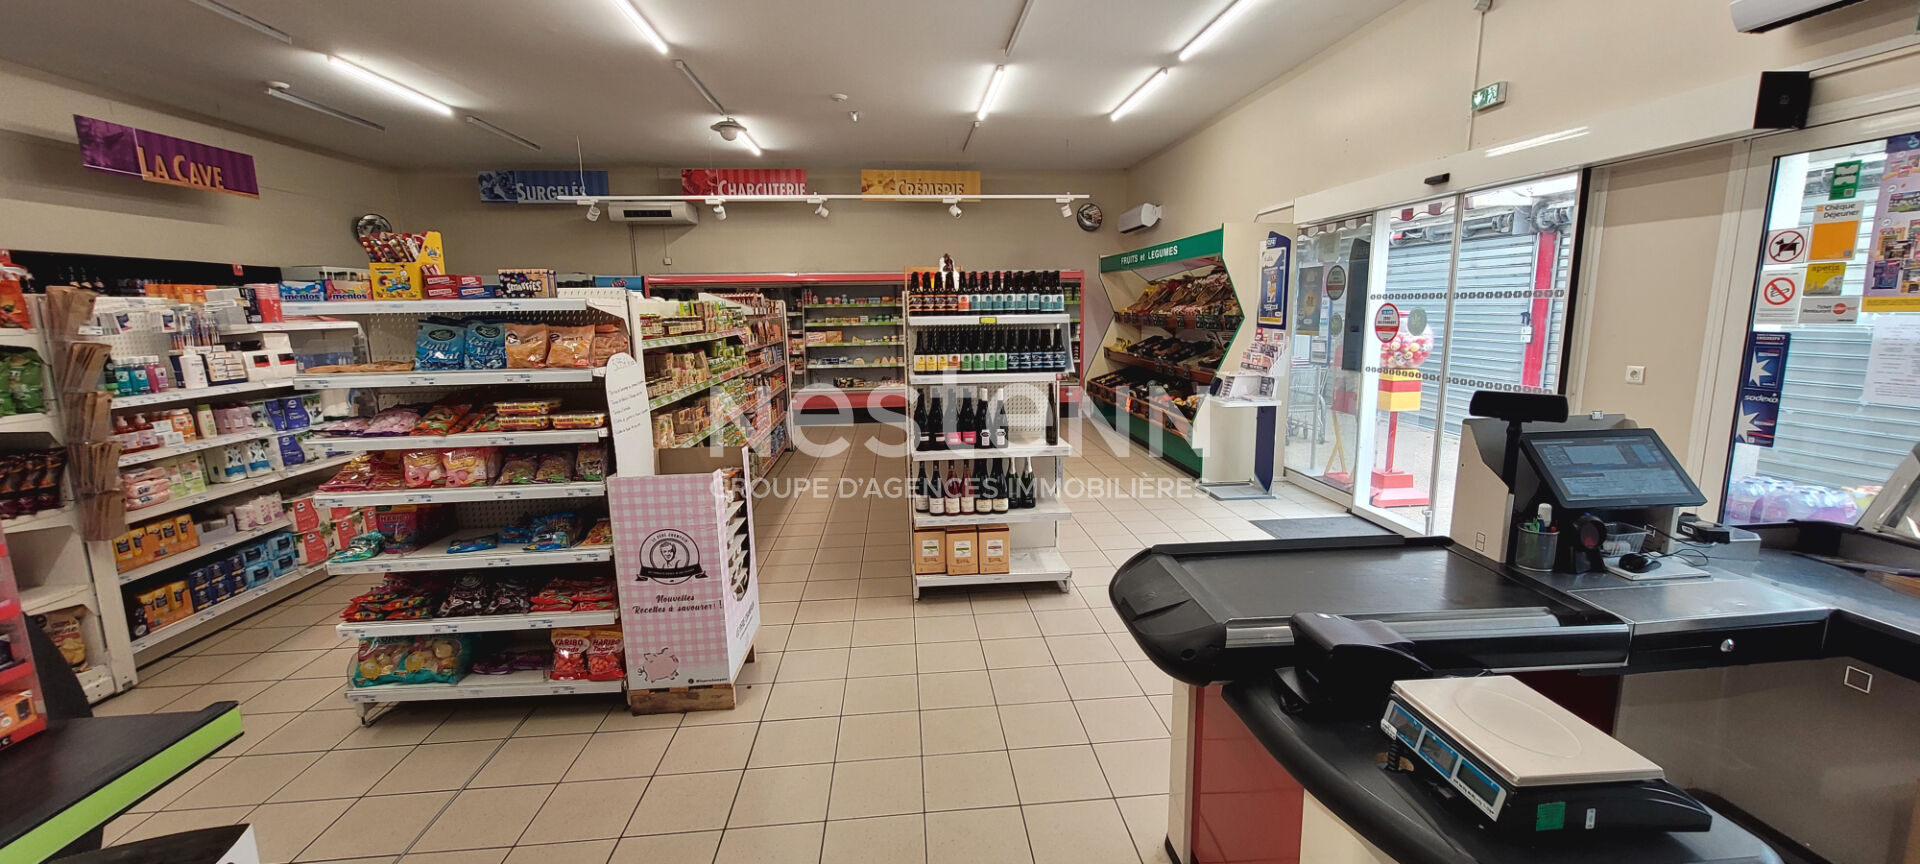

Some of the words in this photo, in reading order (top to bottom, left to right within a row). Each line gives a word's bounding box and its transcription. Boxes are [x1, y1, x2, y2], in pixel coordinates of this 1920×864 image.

[138, 146, 169, 180] LA
[174, 155, 224, 190] CAVE
[718, 180, 806, 195] CHARCUTERIE
[1121, 255, 1138, 264] FRUITS
[1140, 253, 1145, 261] et
[1148, 245, 1178, 259] LEGUMES
[285, 292, 320, 300] mentos
[1745, 394, 1779, 403] sodexo
[656, 594, 694, 603] Nouvelles
[633, 605, 665, 614] Recettes
